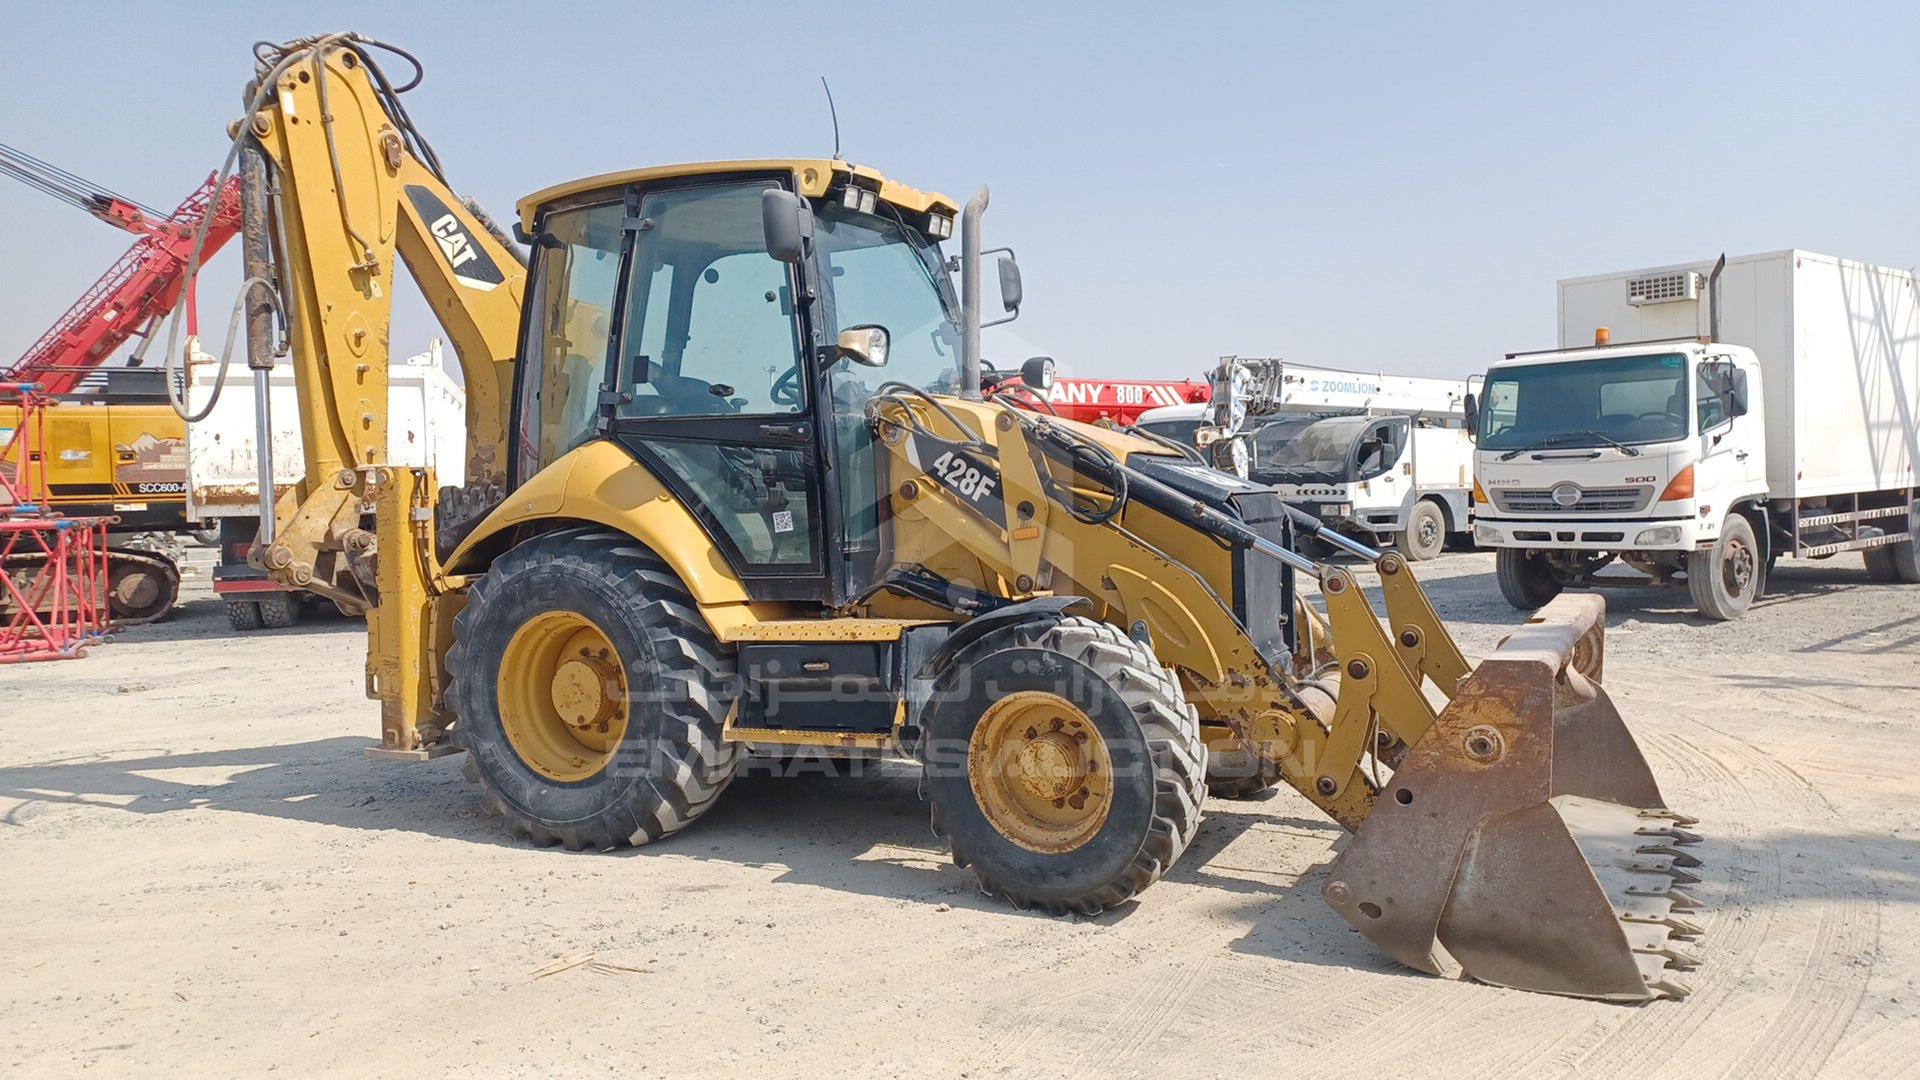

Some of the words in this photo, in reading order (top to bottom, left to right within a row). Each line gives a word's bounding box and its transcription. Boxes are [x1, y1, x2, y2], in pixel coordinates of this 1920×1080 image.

[431, 213, 478, 268] CAT
[1116, 386, 1142, 404] 800
[1322, 380, 1376, 395] ZOOMLION
[933, 451, 996, 502] 428F
[1624, 475, 1656, 483] 500
